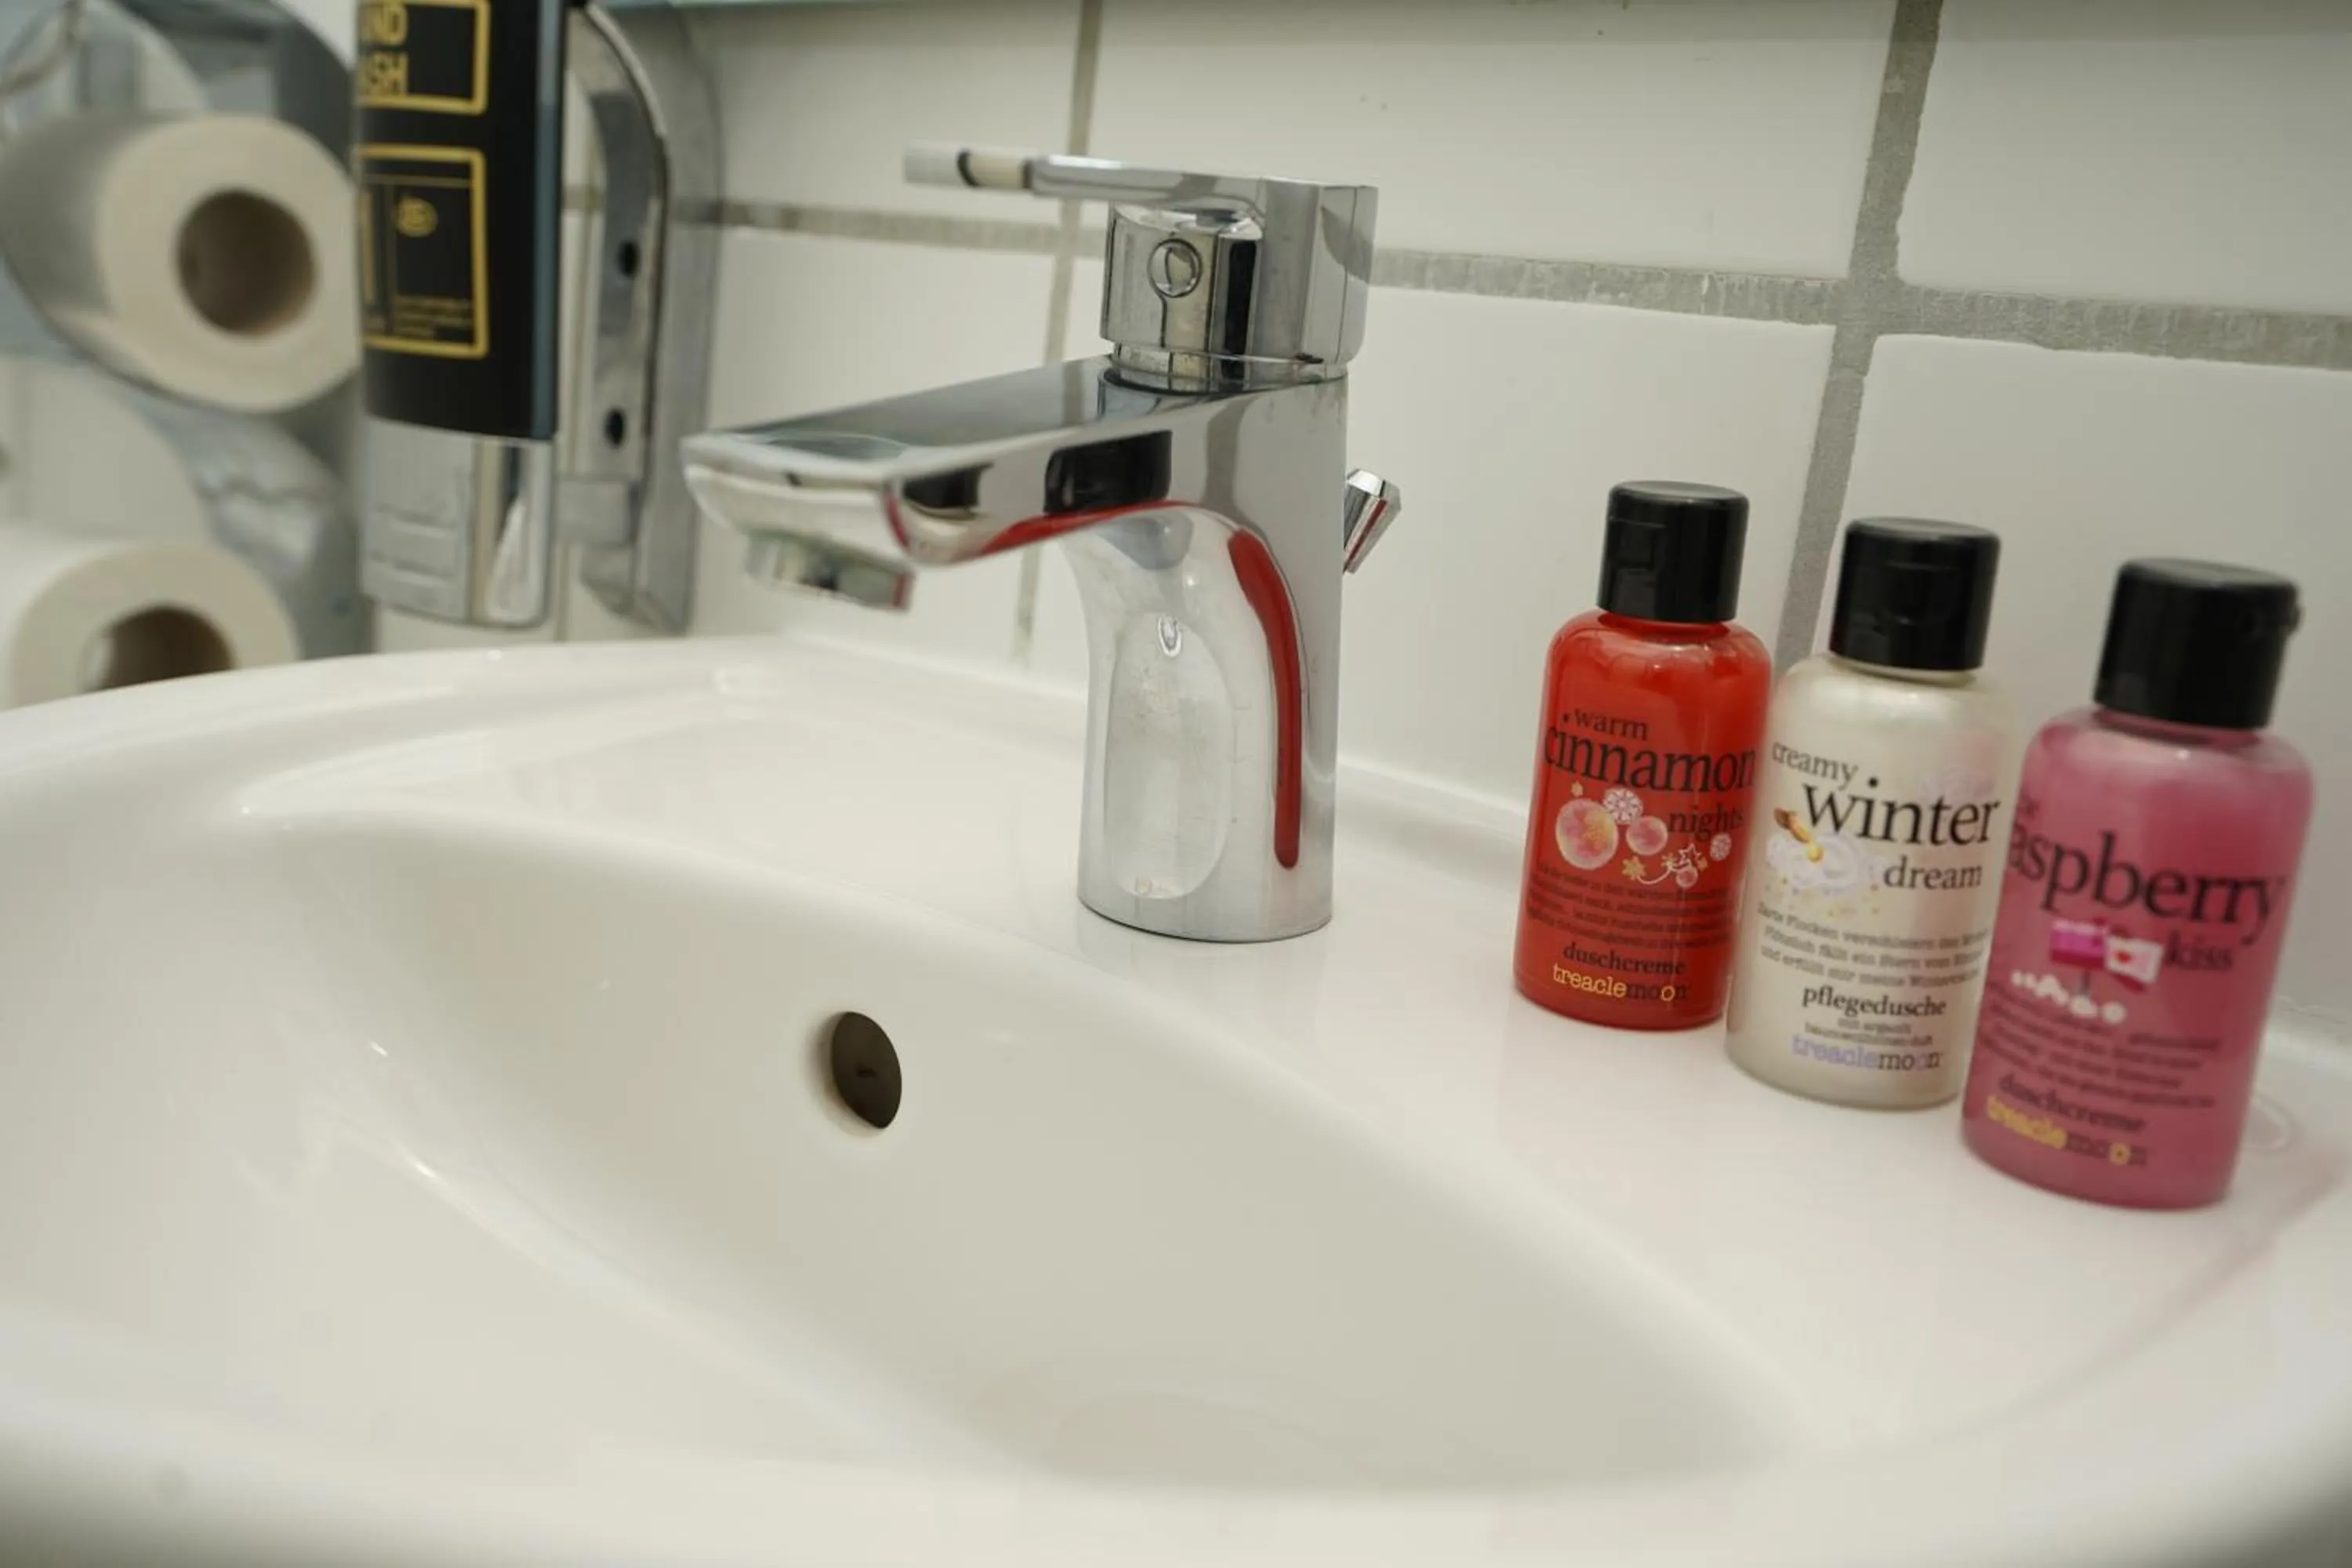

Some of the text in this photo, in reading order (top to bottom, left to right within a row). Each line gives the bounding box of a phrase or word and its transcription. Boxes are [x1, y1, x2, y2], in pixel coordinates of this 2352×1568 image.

[1574, 709, 1649, 741] warm
[1544, 713, 1756, 793] cinnamon
[1771, 742, 1859, 791] creamy
[1668, 801, 1744, 842] nights
[1802, 775, 2001, 846] winter
[1883, 855, 1982, 890] dream
[2009, 822, 2285, 946] aspberry
[1563, 941, 1686, 975] duschcreme
[1553, 964, 1688, 1002] treaclemoon
[1802, 985, 1947, 1018] pflegedusche
[1792, 1034, 1941, 1071] treaclemoon
